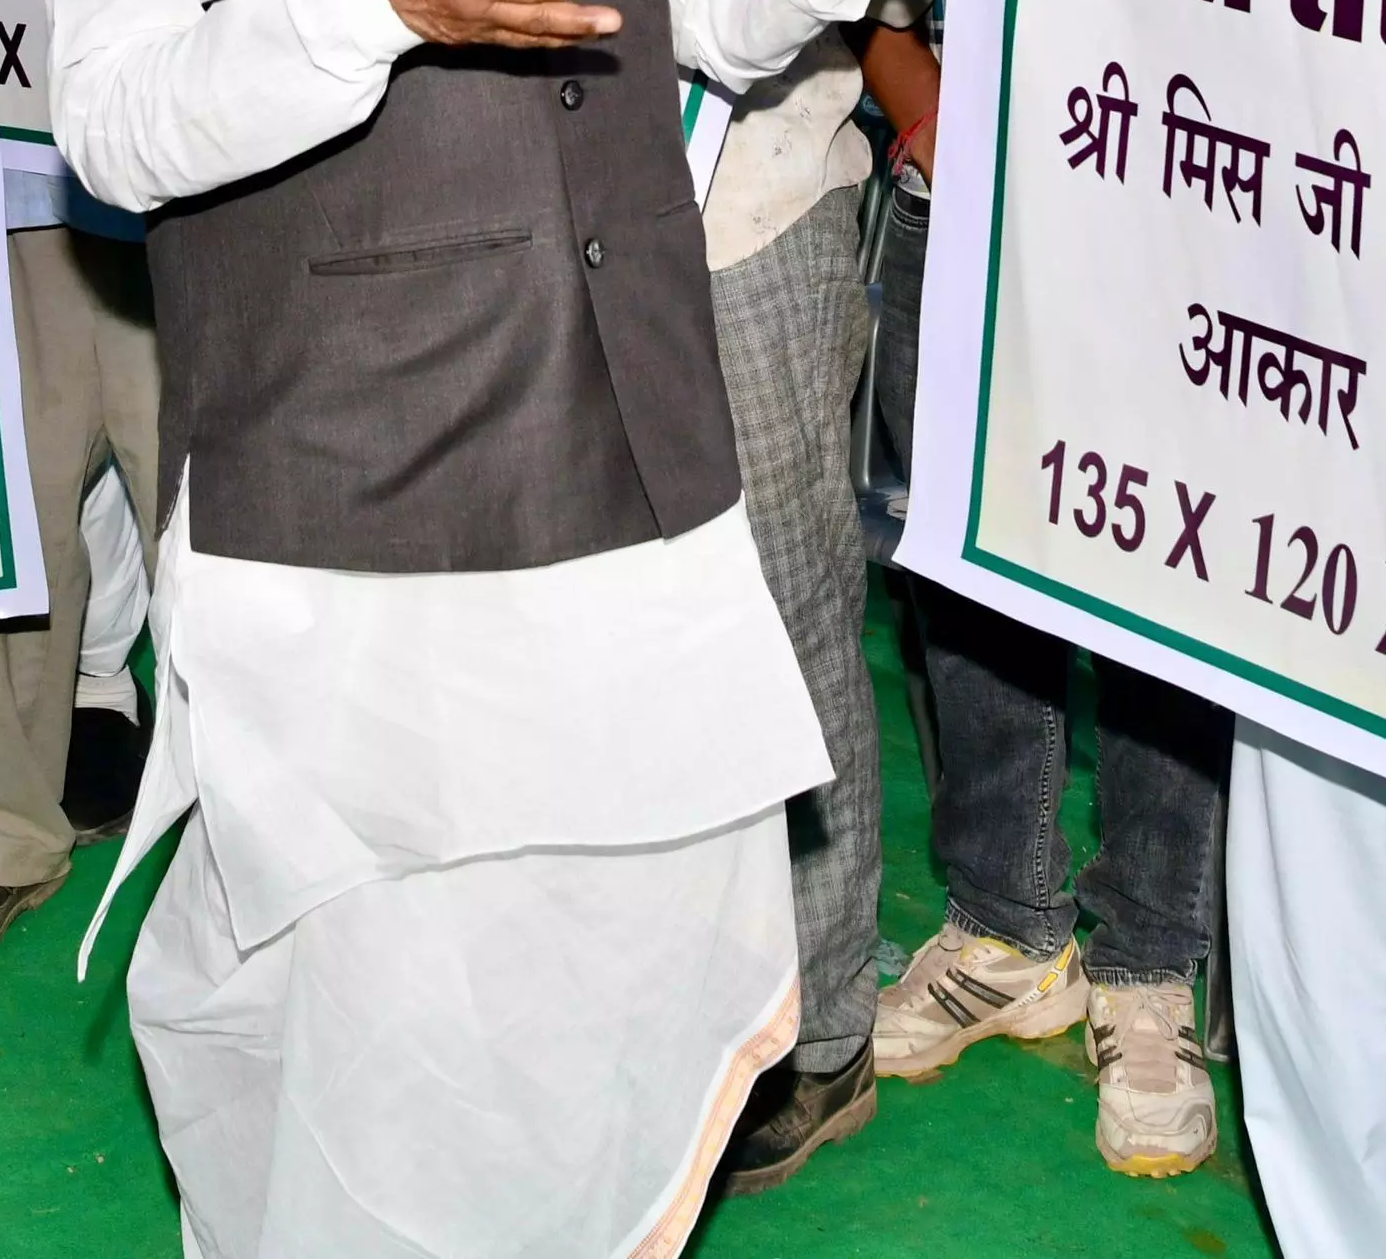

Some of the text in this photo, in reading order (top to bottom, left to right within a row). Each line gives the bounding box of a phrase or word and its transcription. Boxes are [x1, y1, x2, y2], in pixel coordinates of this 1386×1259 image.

[1059, 62, 1138, 183] श्री
[1162, 74, 1270, 227] मिस
[1295, 129, 1371, 260] जी
[1179, 303, 1366, 451] आकार
[1042, 440, 1149, 552] 135
[1166, 482, 1216, 581] X
[1246, 514, 1358, 635] 120
